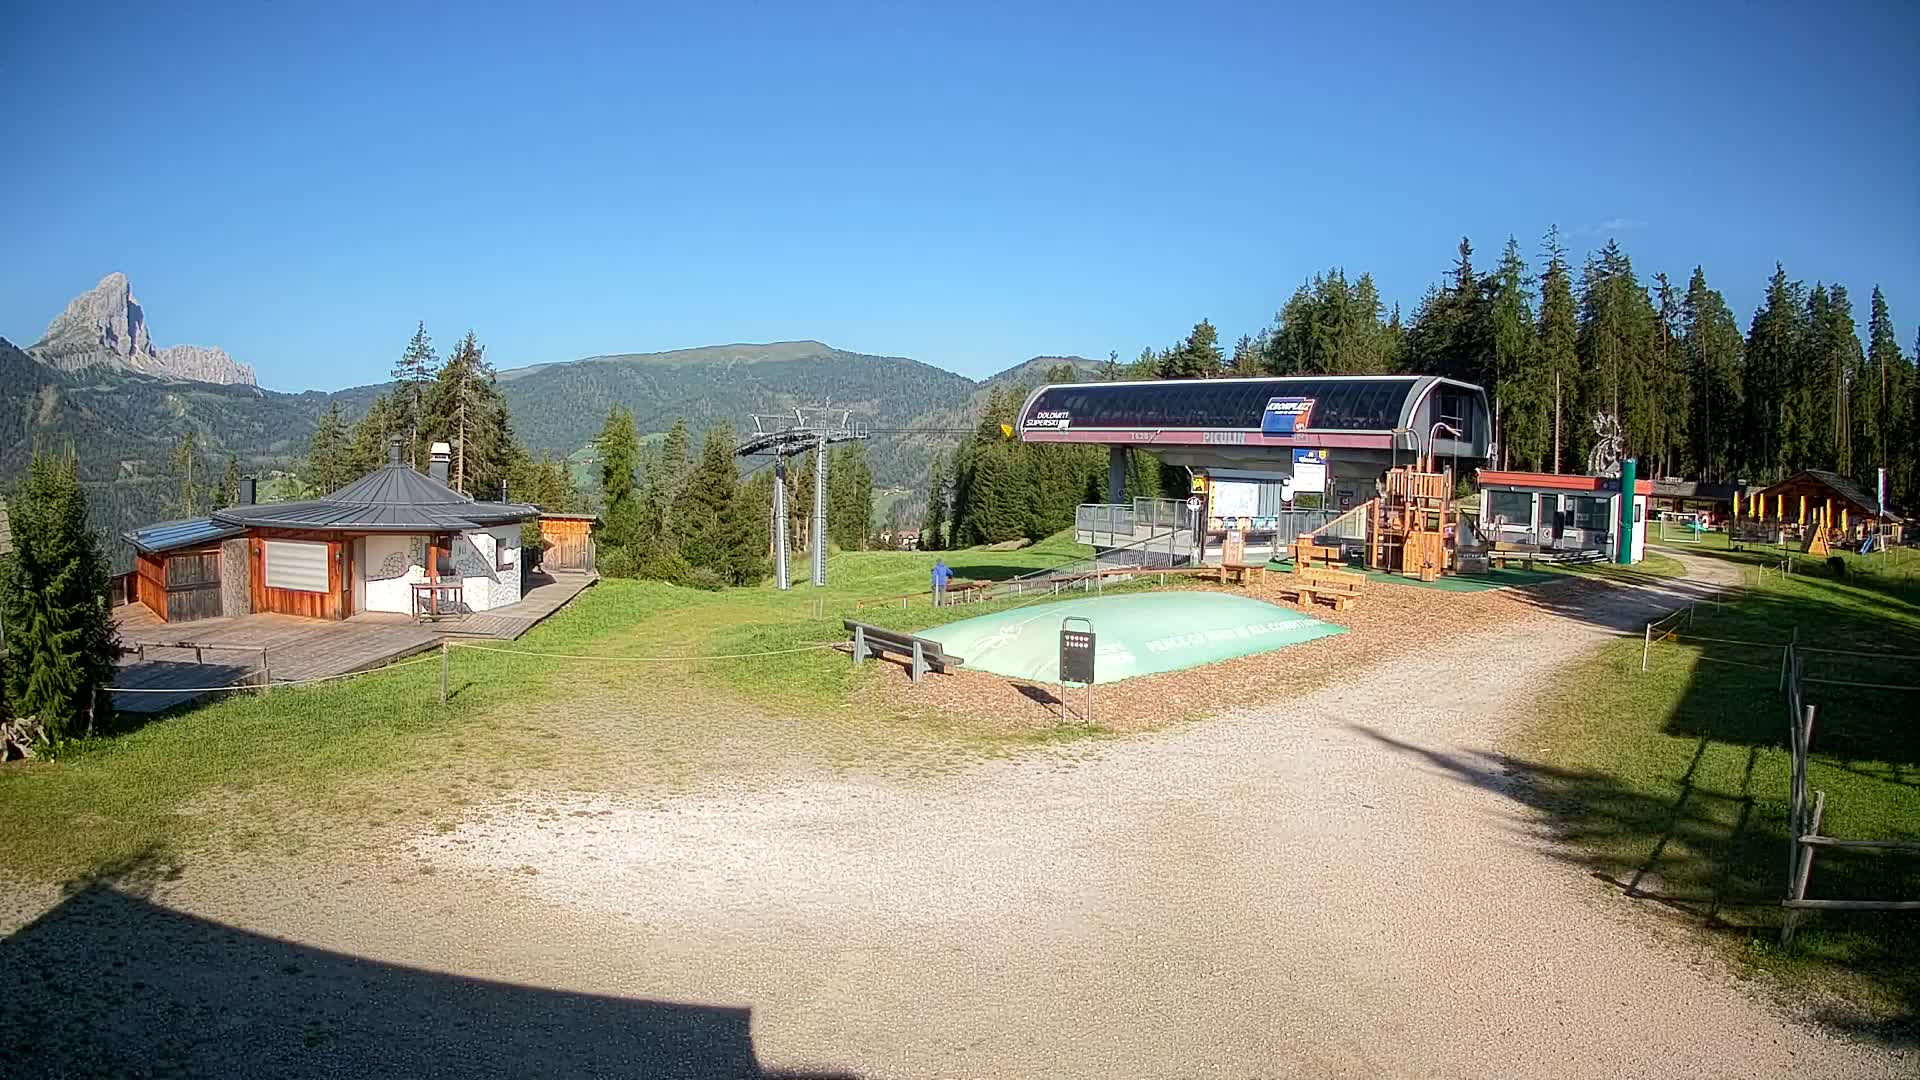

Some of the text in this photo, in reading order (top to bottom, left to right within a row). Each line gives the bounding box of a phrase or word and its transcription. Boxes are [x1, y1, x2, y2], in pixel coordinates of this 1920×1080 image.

[1036, 411, 1069, 419] DOLOMITI
[1026, 419, 1059, 427] SUPERSKI
[1202, 432, 1246, 444] PICULIN
